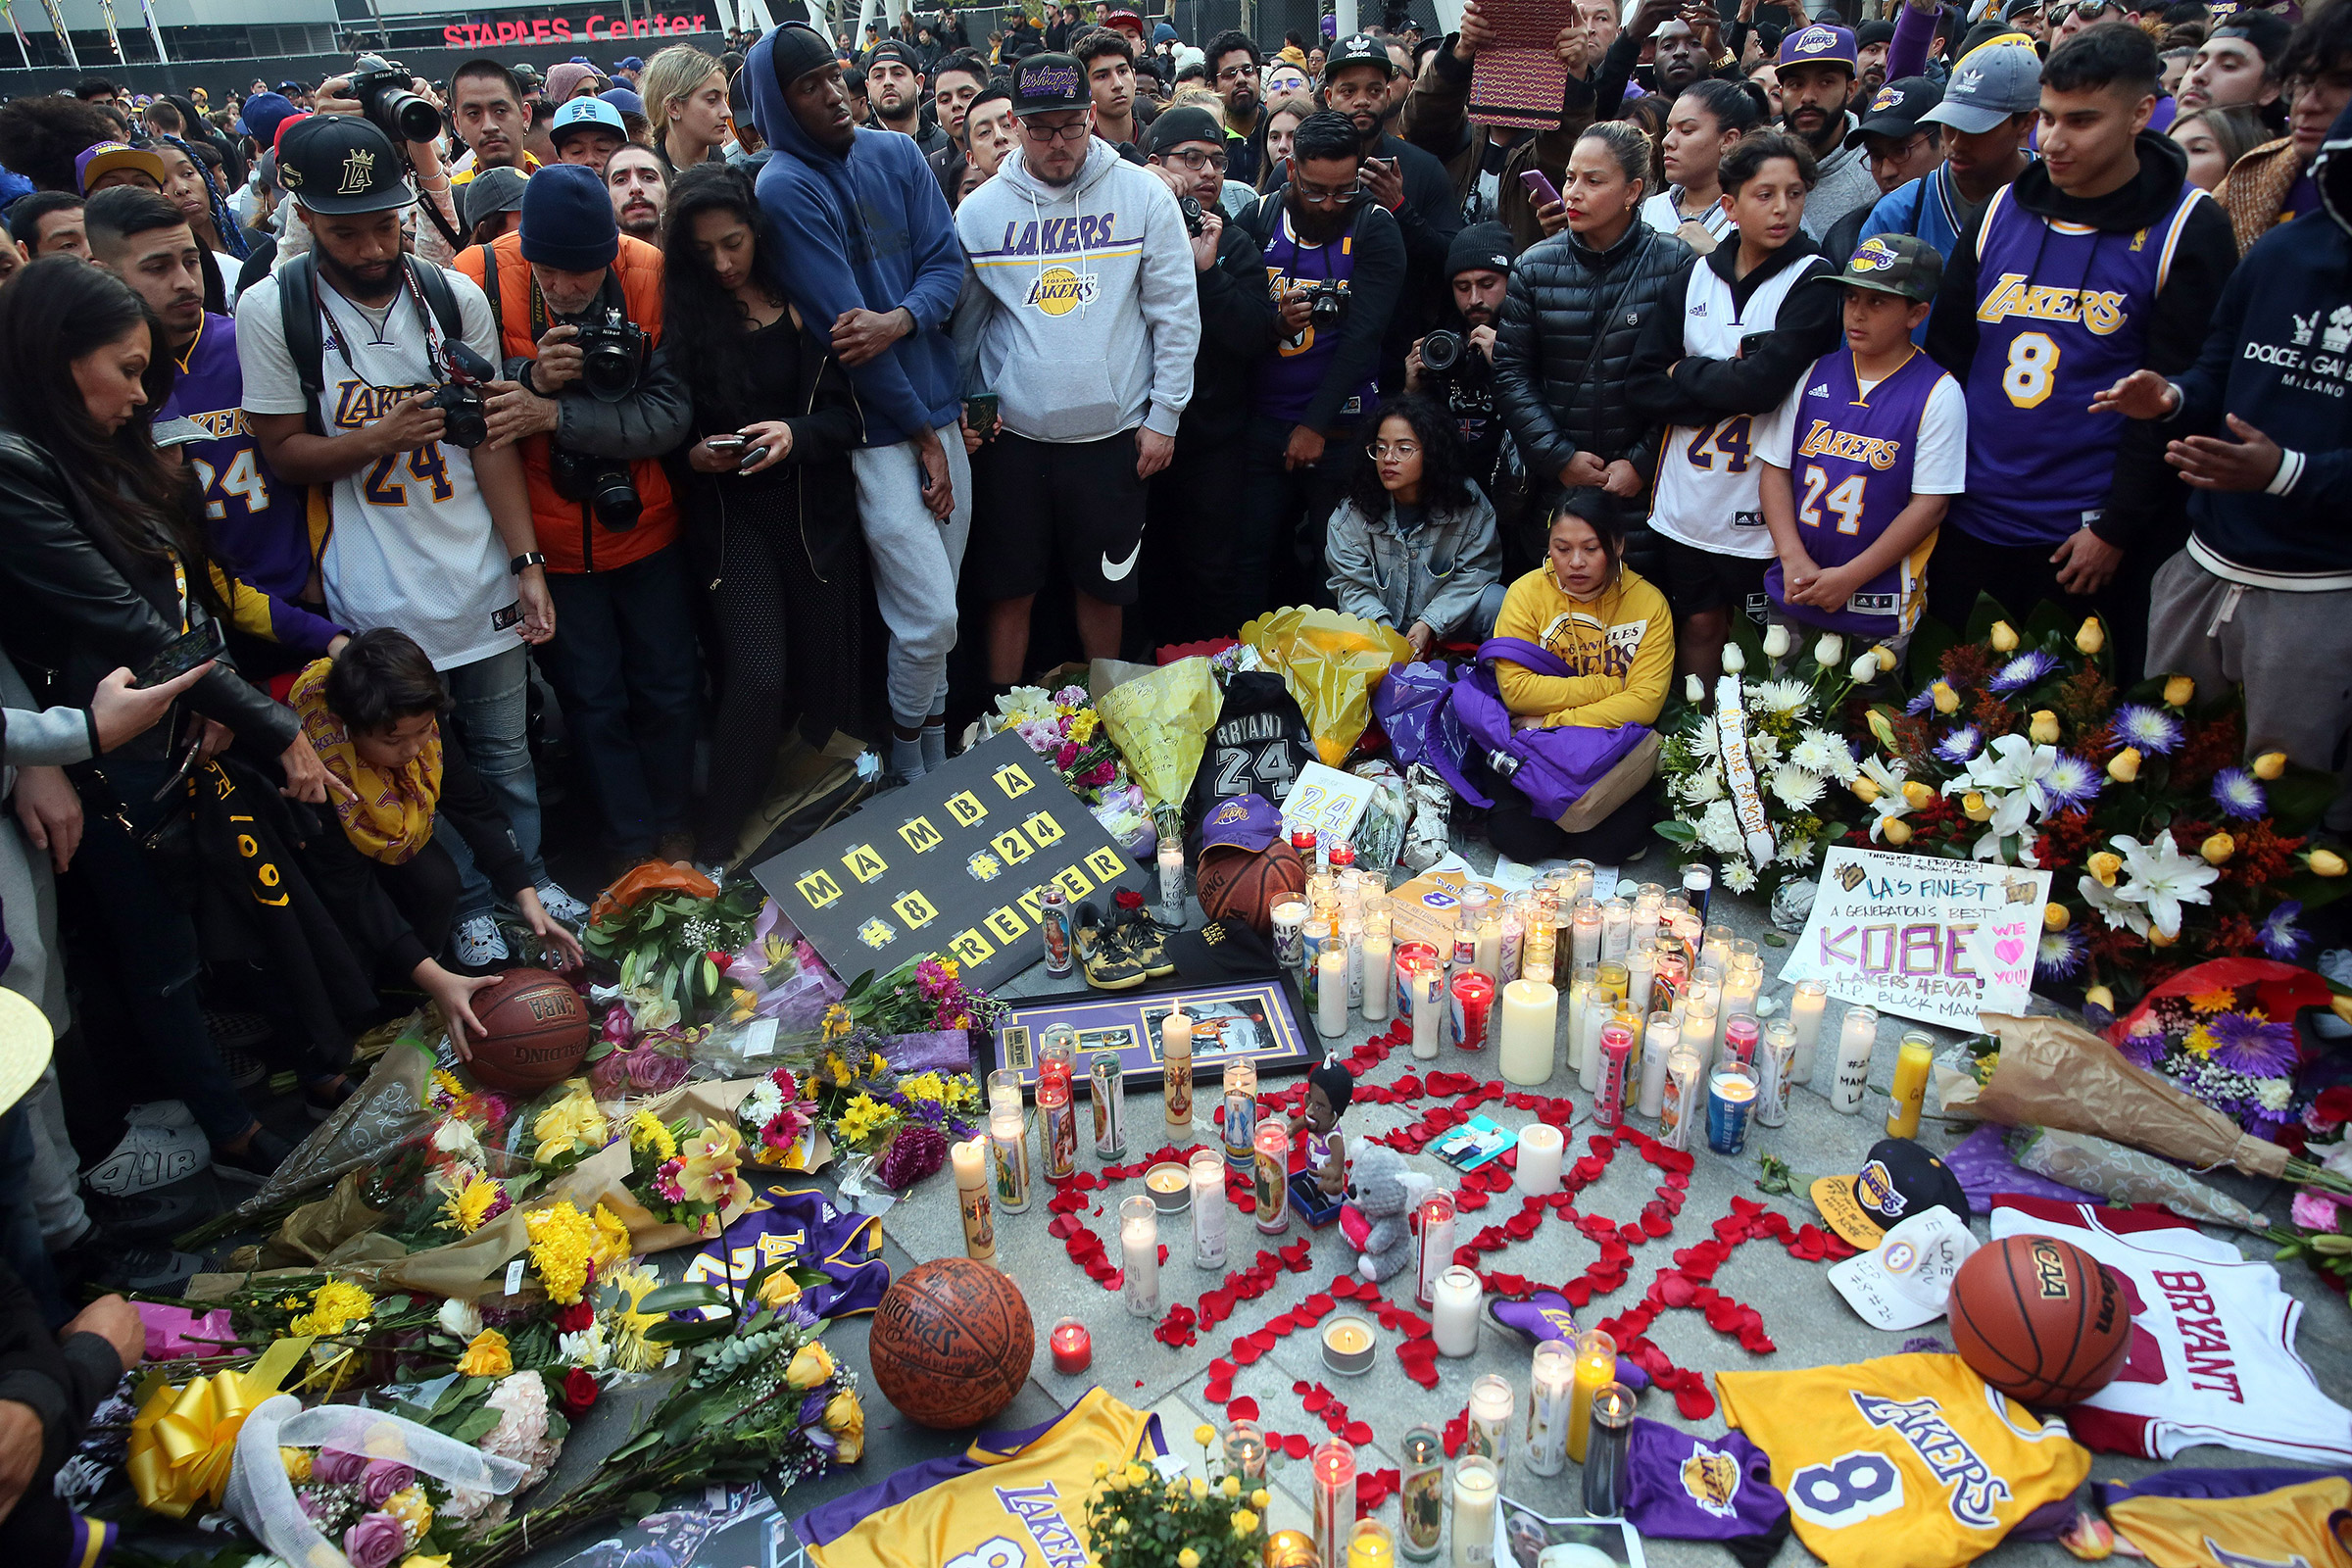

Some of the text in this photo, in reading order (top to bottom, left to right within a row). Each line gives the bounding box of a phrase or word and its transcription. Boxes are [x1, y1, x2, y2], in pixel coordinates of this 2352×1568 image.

[443, 14, 706, 49] STAPLES Center
[1346, 50, 1372, 59] adidas
[1019, 65, 1079, 91] Los Angeles
[337, 158, 374, 194] LA
[1002, 212, 1116, 256] LAKERS
[535, 287, 544, 323] Nikon
[1027, 278, 1100, 306] LAKERS
[1977, 272, 2129, 335] LAKERS
[2001, 331, 2061, 410] 8
[2243, 341, 2302, 368] DOLCE
[2298, 360, 2307, 369] &
[1808, 389, 1830, 399] adidas
[2280, 373, 2345, 398] MILANO
[1798, 419, 1901, 470] LAKERS
[364, 443, 455, 507] 24
[1799, 465, 1868, 536] 24
[1215, 739, 1297, 801] 24
[801, 767, 1030, 904] MAMBA
[1422, 892, 1456, 908] 8
[1920, 878, 1993, 902] FINEST
[1830, 906, 1839, 917] A
[1845, 904, 1937, 918] GENERATION'S
[1991, 921, 2027, 936] WE
[1820, 922, 1980, 979] KOBE
[1994, 968, 2028, 988] YOU!
[1878, 990, 1980, 1020] BLACK MAM
[1014, 1030, 1027, 1065] Kobe Bryant
[1724, 1102, 1735, 1112] FE
[88, 1149, 196, 1194] AIR
[1887, 1245, 1912, 1269] 8
[1919, 1253, 1936, 1286] YOU
[1939, 1239, 1954, 1277] LOVE
[879, 1290, 961, 1358] SPALDIN
[2151, 1269, 2245, 1405] BRYANT
[1850, 1389, 2013, 1530] LAKERS
[1787, 1450, 1904, 1530] 8
